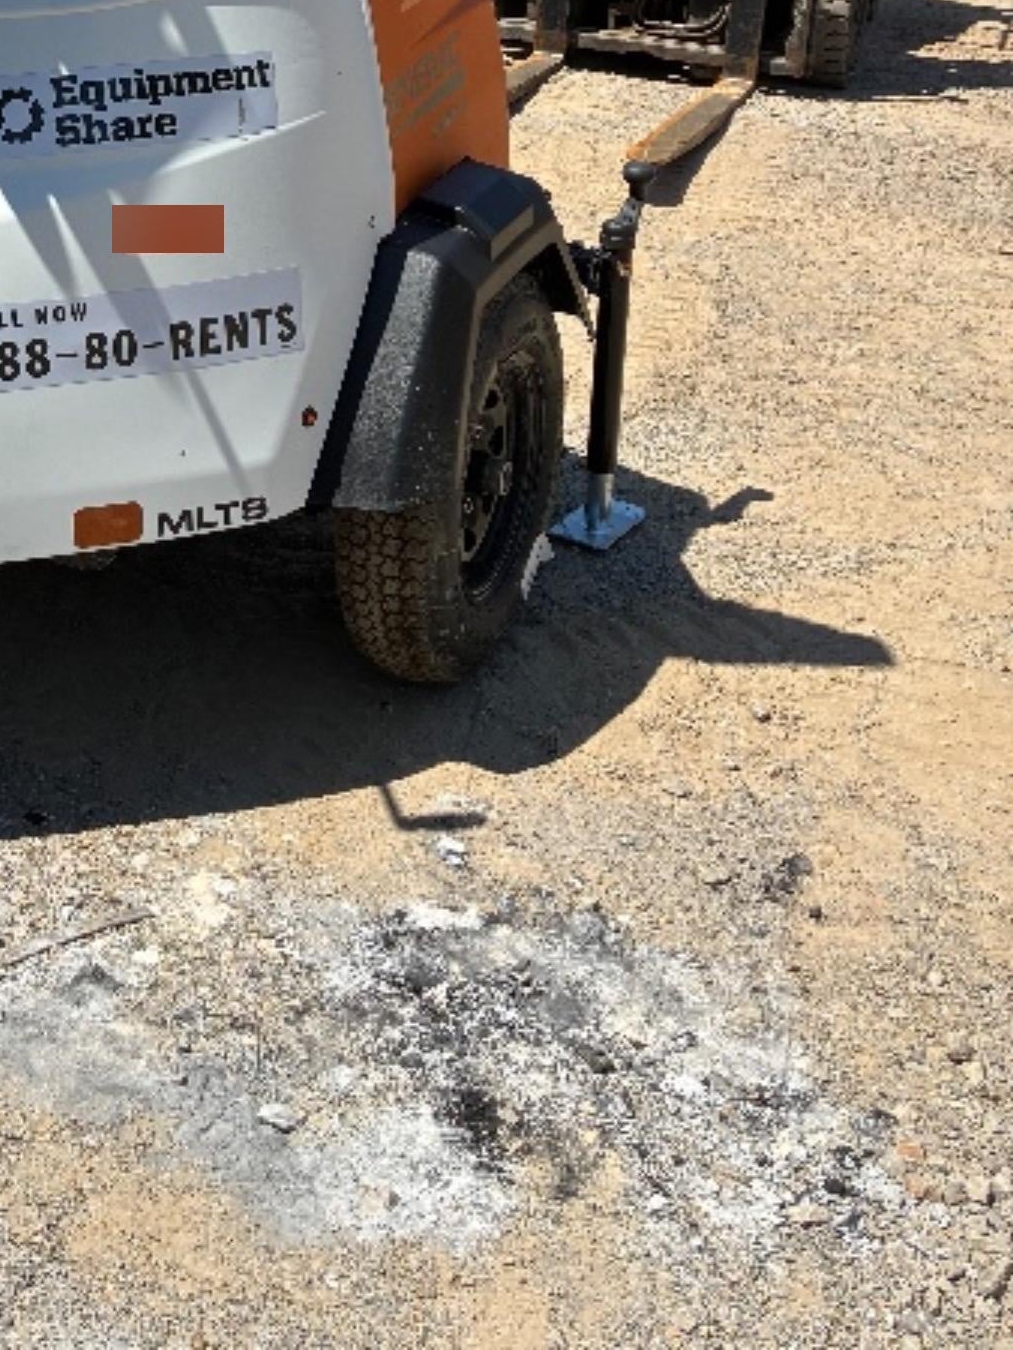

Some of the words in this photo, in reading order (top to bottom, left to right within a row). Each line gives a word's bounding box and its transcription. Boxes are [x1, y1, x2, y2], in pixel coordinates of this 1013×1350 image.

[49, 58, 271, 112] Equipment
[54, 112, 178, 148] Share
[34, 301, 87, 325] NOW
